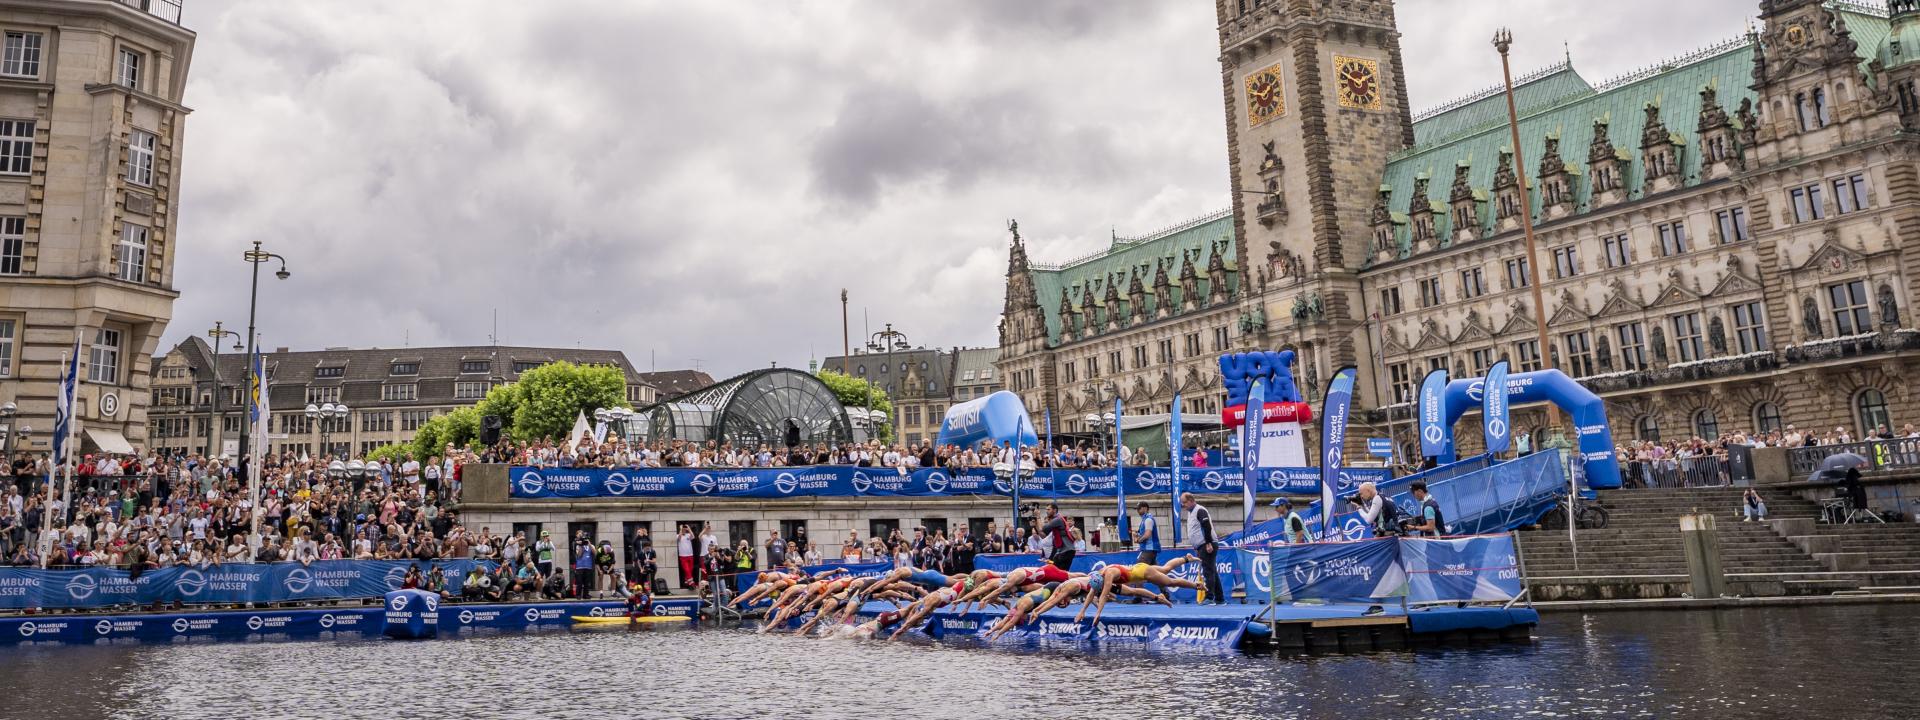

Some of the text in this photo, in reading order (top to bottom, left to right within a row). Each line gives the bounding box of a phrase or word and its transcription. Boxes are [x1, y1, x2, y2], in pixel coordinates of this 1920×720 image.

[1506, 378, 1533, 387] MBURG
[1507, 387, 1525, 395] SSER
[1336, 403, 1345, 444] Triathlon
[1329, 415, 1337, 444] World
[1261, 430, 1294, 438] UZUKI
[546, 475, 590, 483] HAMBURG
[799, 474, 837, 482] HAMBURG
[873, 475, 912, 483] HAMBURG
[1024, 476, 1053, 484] MBURG
[546, 483, 580, 491] WASSER
[632, 483, 665, 491] WASSER
[718, 483, 750, 491] WASSER
[874, 482, 904, 490] WASSER
[1232, 531, 1270, 547] HAMBURG
[209, 573, 260, 582] HAMBURG
[315, 570, 361, 578] HAMBURG
[0, 577, 40, 586] MBURG
[99, 576, 150, 585] HAMBURG
[316, 579, 350, 587] WASSER
[99, 586, 138, 594] WASSER
[210, 582, 248, 591] WASSER
[0, 587, 26, 596] SSER
[1047, 622, 1081, 635] SUZUKI
[1108, 624, 1148, 637] SUZUKI
[1171, 626, 1219, 640] SUZUKI
